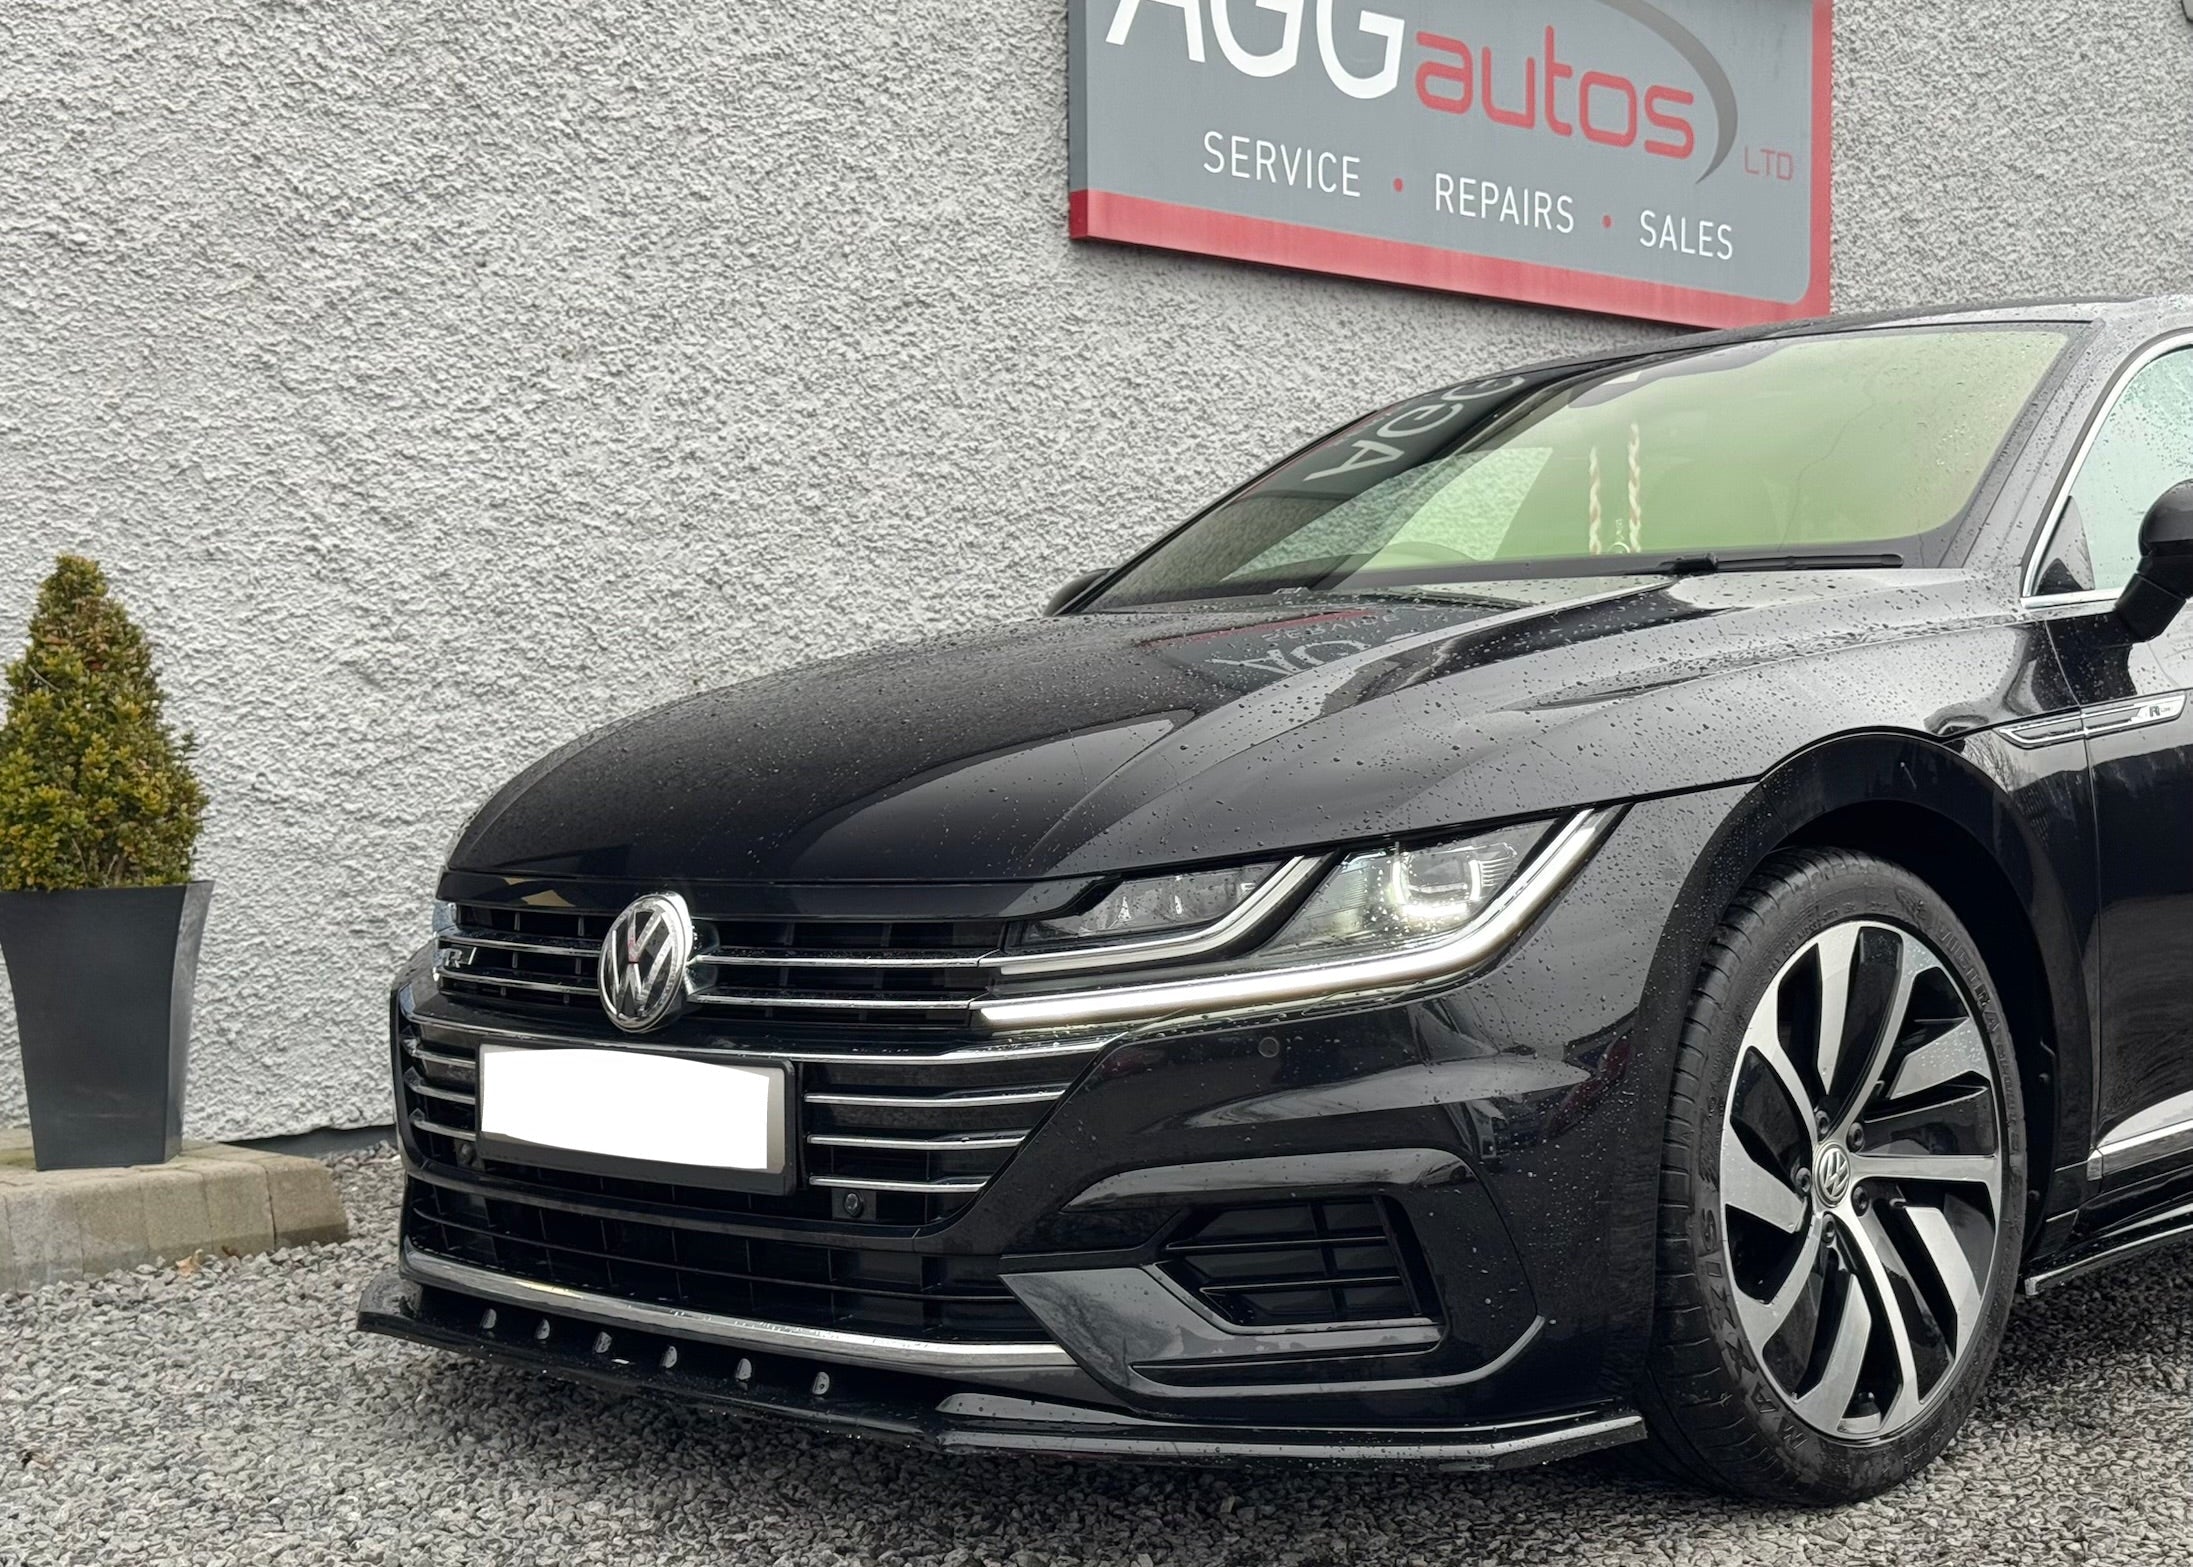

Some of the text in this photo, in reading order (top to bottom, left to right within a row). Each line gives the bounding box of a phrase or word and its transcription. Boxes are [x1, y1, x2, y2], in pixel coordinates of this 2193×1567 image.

[1415, 25, 1694, 160] autos
[1203, 131, 1733, 260] SERVICE REPAIRS SALES
[1744, 146, 1794, 181] LTD
[1701, 1206, 1809, 1451] MAXXIS
